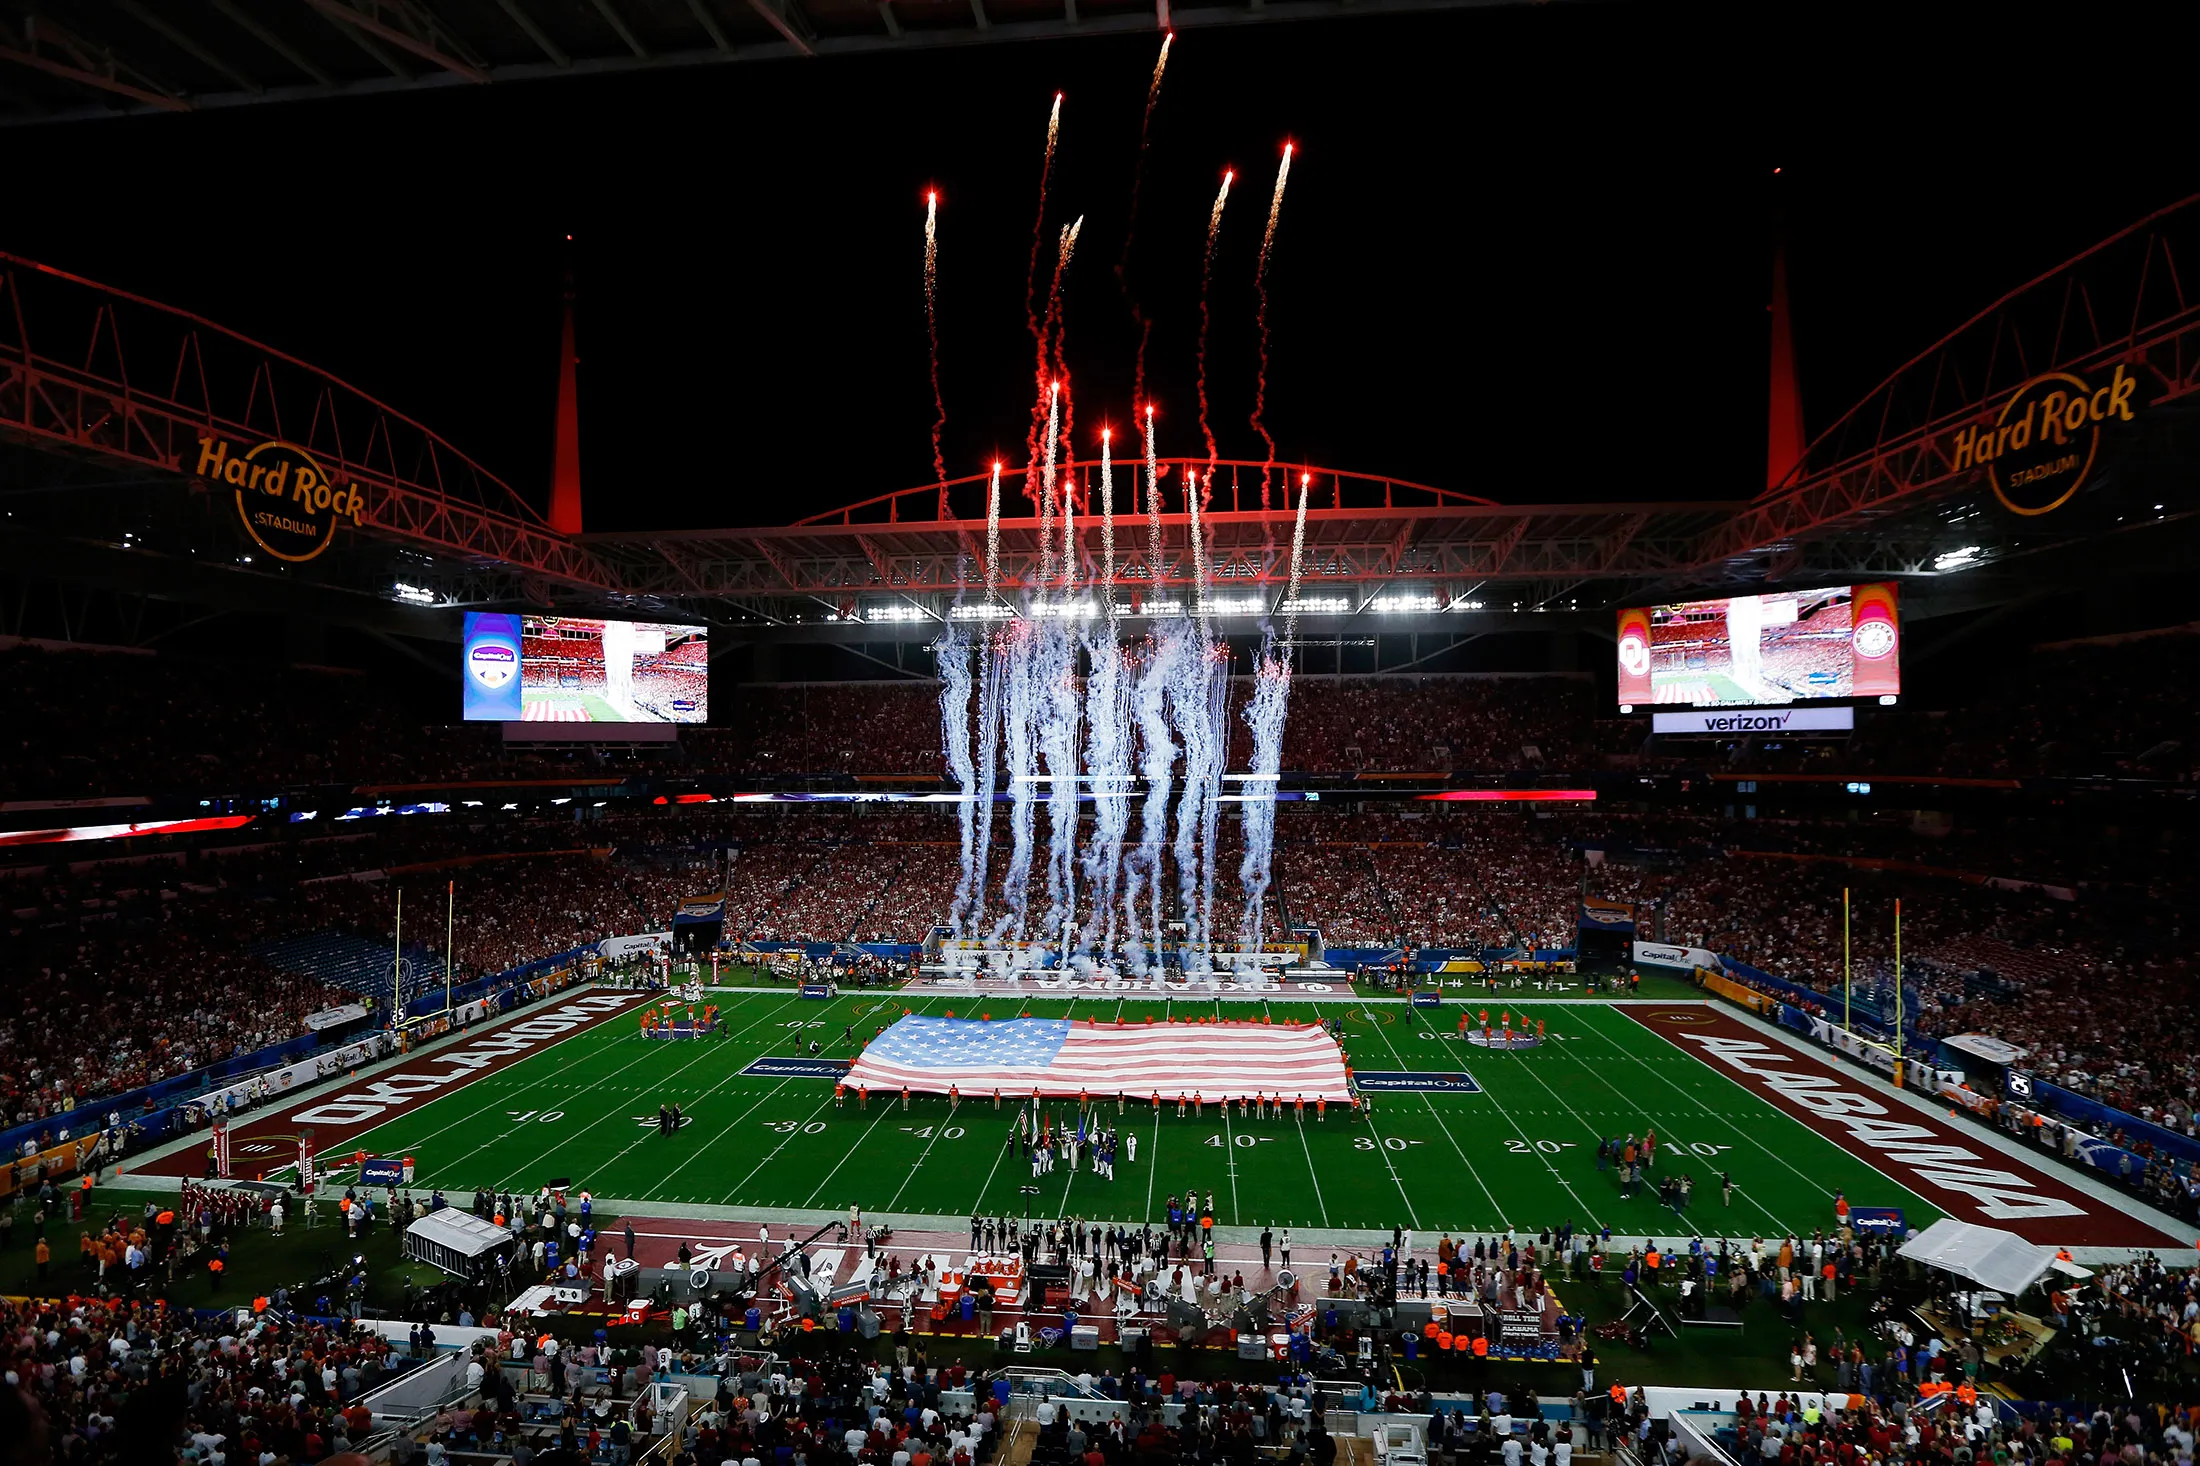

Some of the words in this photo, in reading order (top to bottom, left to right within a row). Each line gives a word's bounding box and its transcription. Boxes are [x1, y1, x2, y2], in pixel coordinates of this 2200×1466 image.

[1952, 401, 2035, 472] Hard
[2040, 364, 2136, 445] Rock
[196, 437, 289, 497] Hard
[292, 466, 365, 527] Rock
[2010, 454, 2077, 488] STADIUM
[256, 511, 317, 537] STADIUM
[1705, 713, 1782, 731] verizon
[291, 993, 646, 1126] OKLAHOMA
[1359, 1079, 1470, 1089] CapitalOne
[2010, 1074, 2030, 1096] 25
[1678, 1033, 2090, 1220] ALABAMA
[631, 1311, 640, 1321] G
[1503, 1314, 1522, 1322] ROLL
[1523, 1315, 1540, 1323] TIDE
[1278, 1347, 1288, 1357] G
